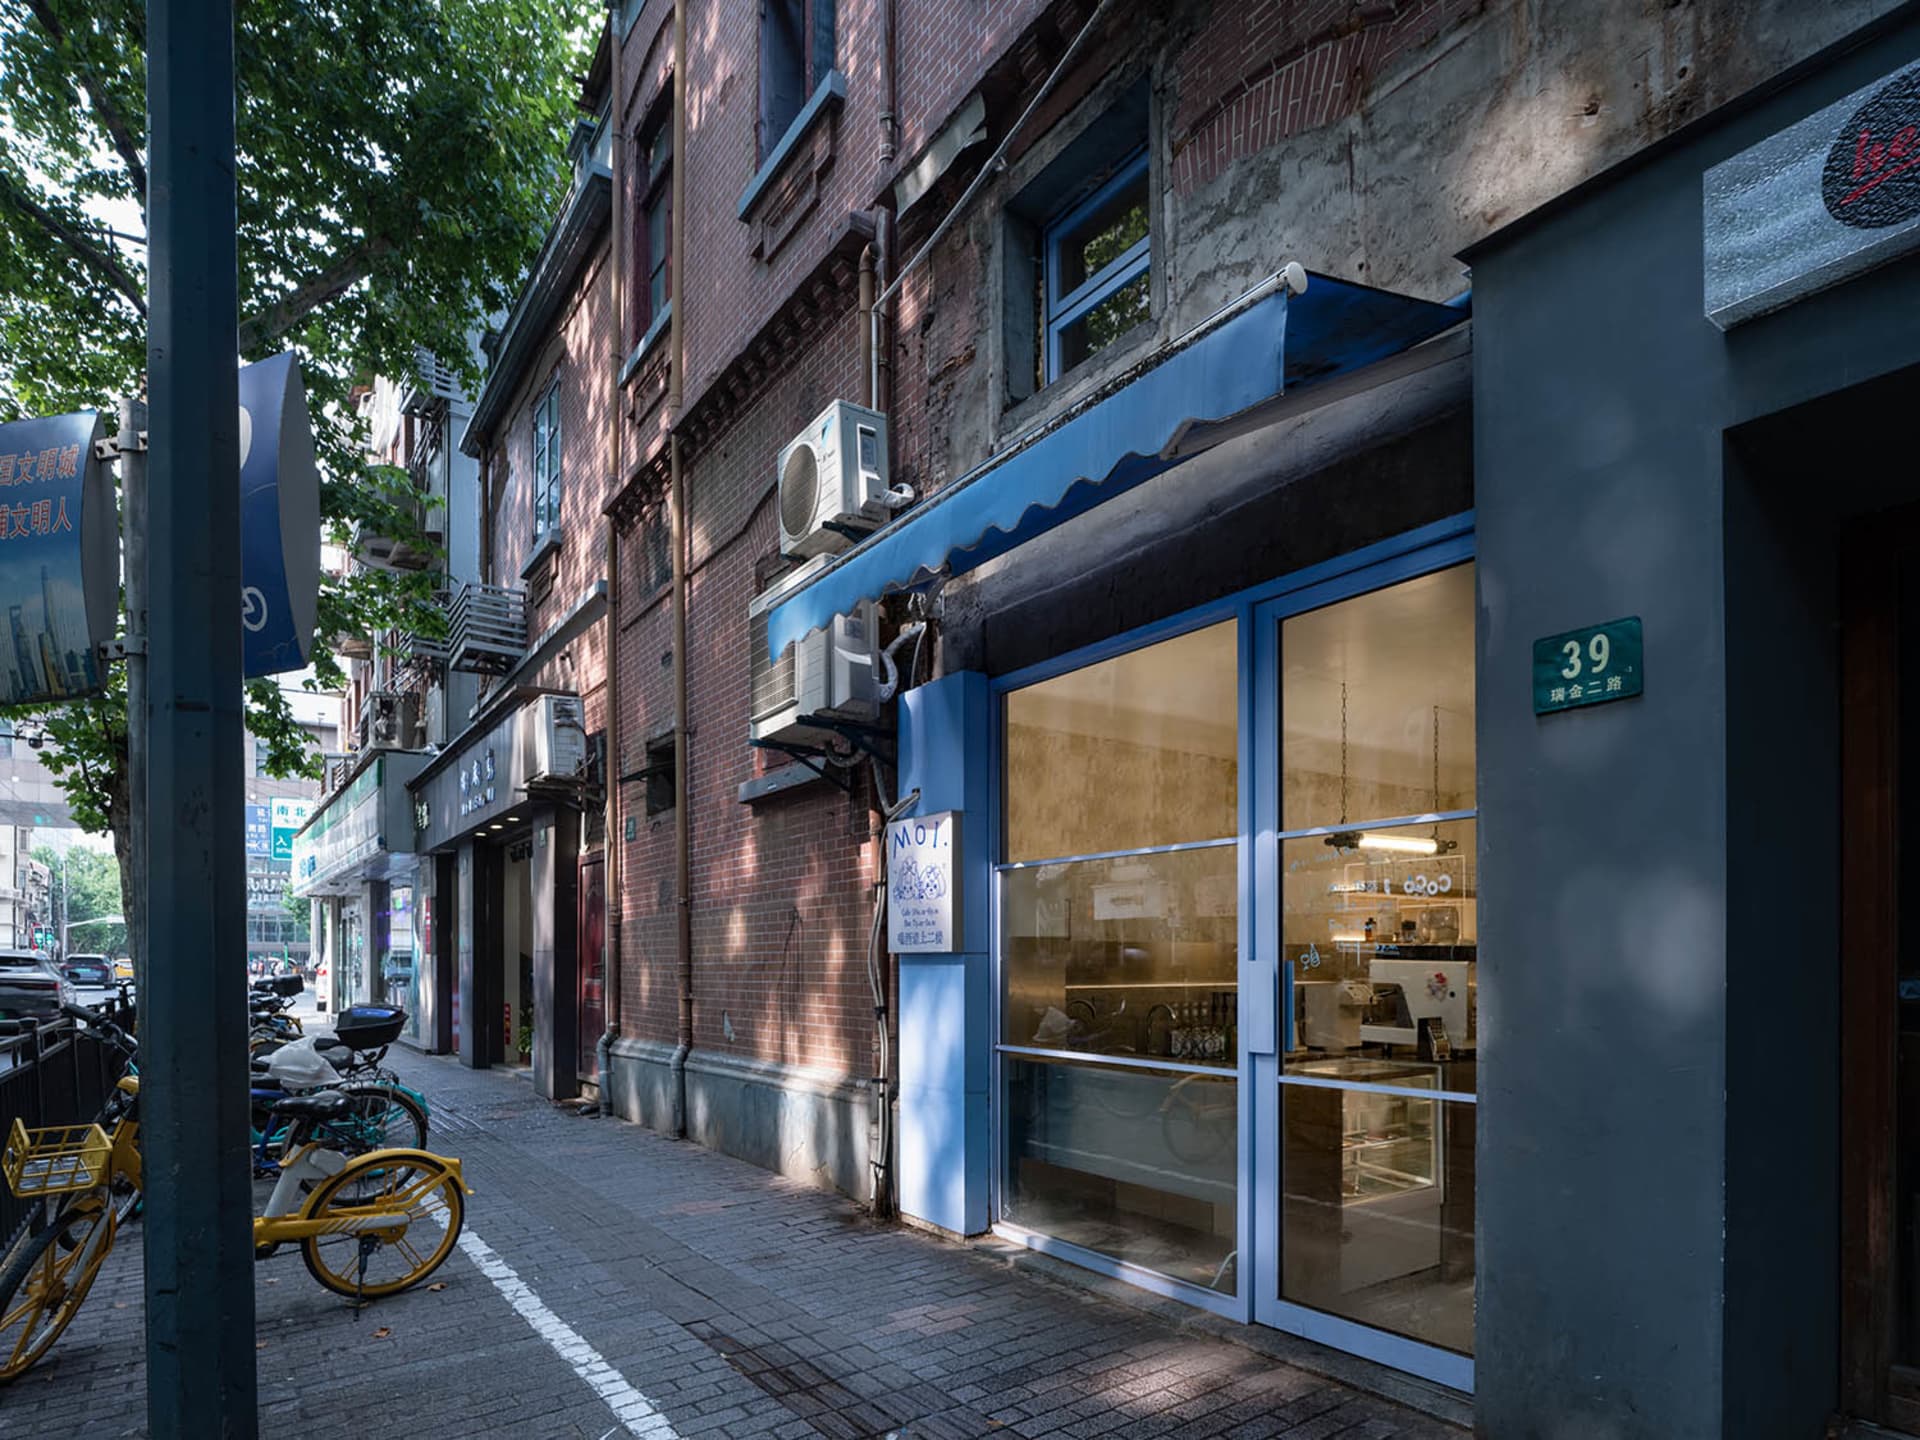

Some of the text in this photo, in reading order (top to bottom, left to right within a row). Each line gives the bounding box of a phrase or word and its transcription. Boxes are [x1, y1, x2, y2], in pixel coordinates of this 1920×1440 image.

[1562, 634, 1610, 679] 39
[1550, 676, 1622, 703] 瑞金二路
